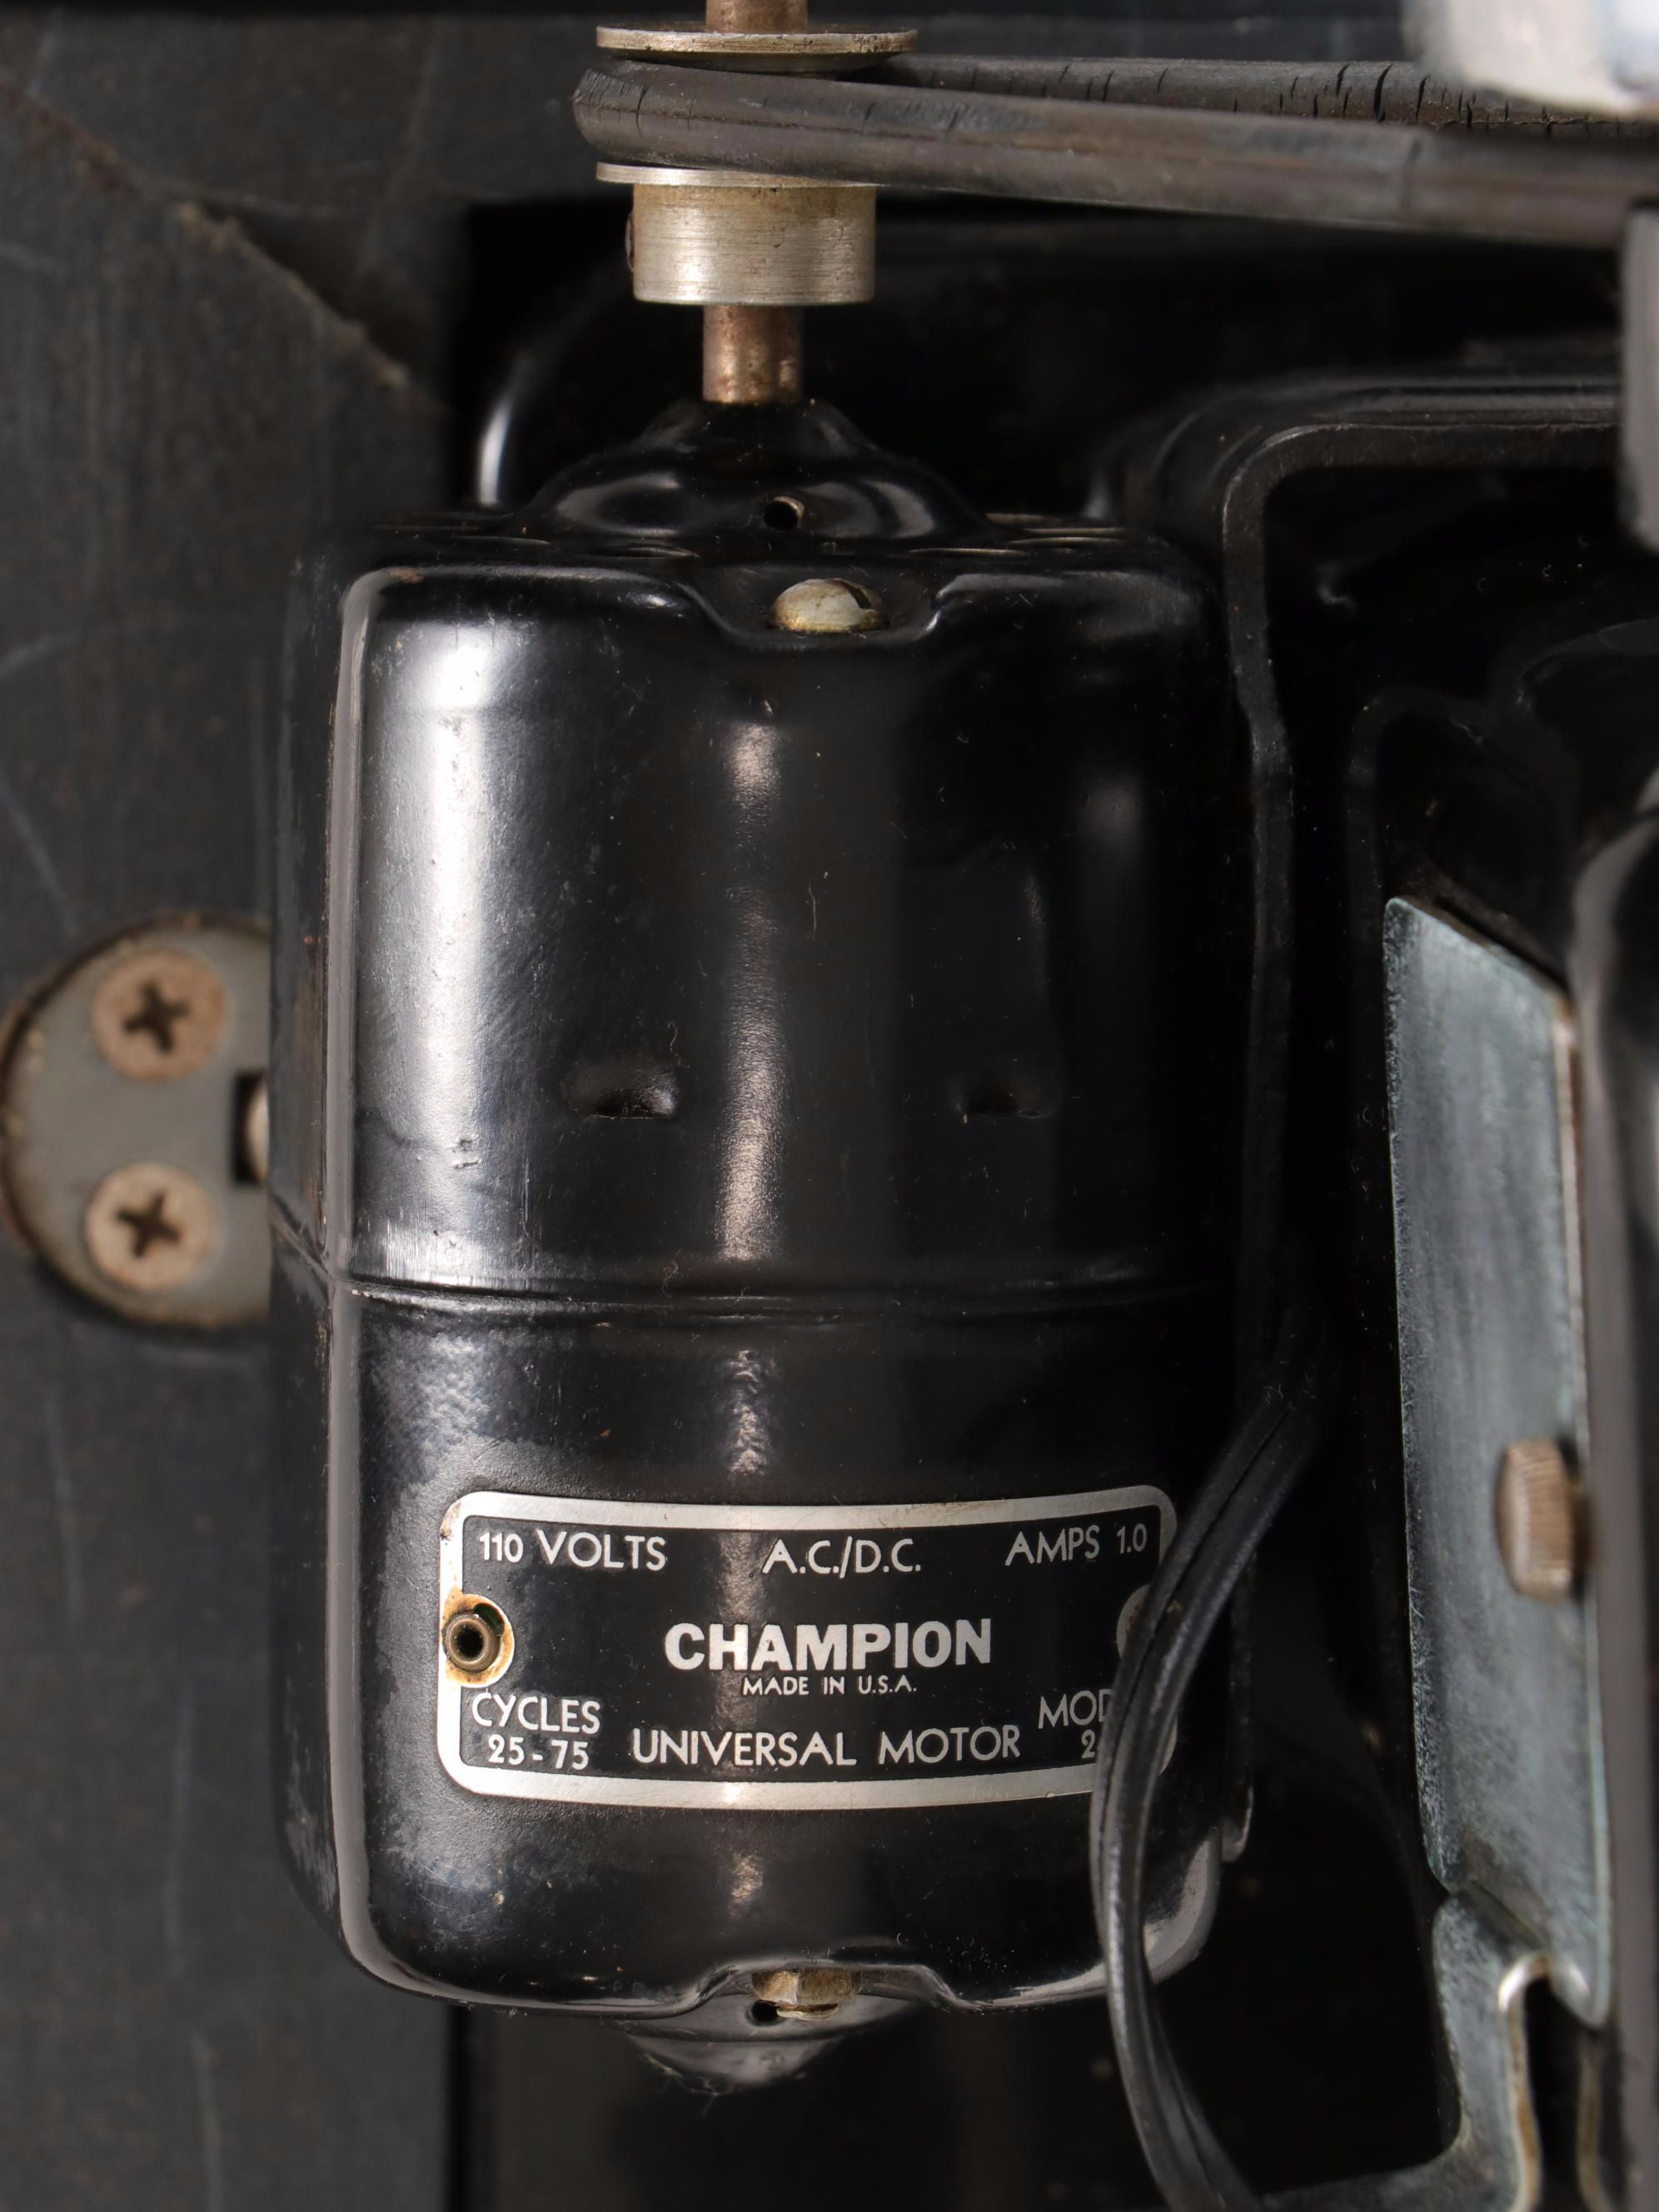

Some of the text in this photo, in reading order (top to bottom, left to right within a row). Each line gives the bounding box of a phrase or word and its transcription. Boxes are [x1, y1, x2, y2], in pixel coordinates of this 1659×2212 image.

[479, 1529, 667, 1572] 110 VOLTS
[761, 1536, 921, 1579] A.C./D.C.
[1004, 1523, 1147, 1567] AMPS 1.0
[664, 1617, 991, 1671] CHAMPION
[742, 1675, 917, 1696] MADE IN U.S.A.
[471, 1692, 601, 1734] CYCLES
[1038, 1687, 1114, 1730] MOD
[632, 1724, 1020, 1767] UNIVERSAL MOTOR
